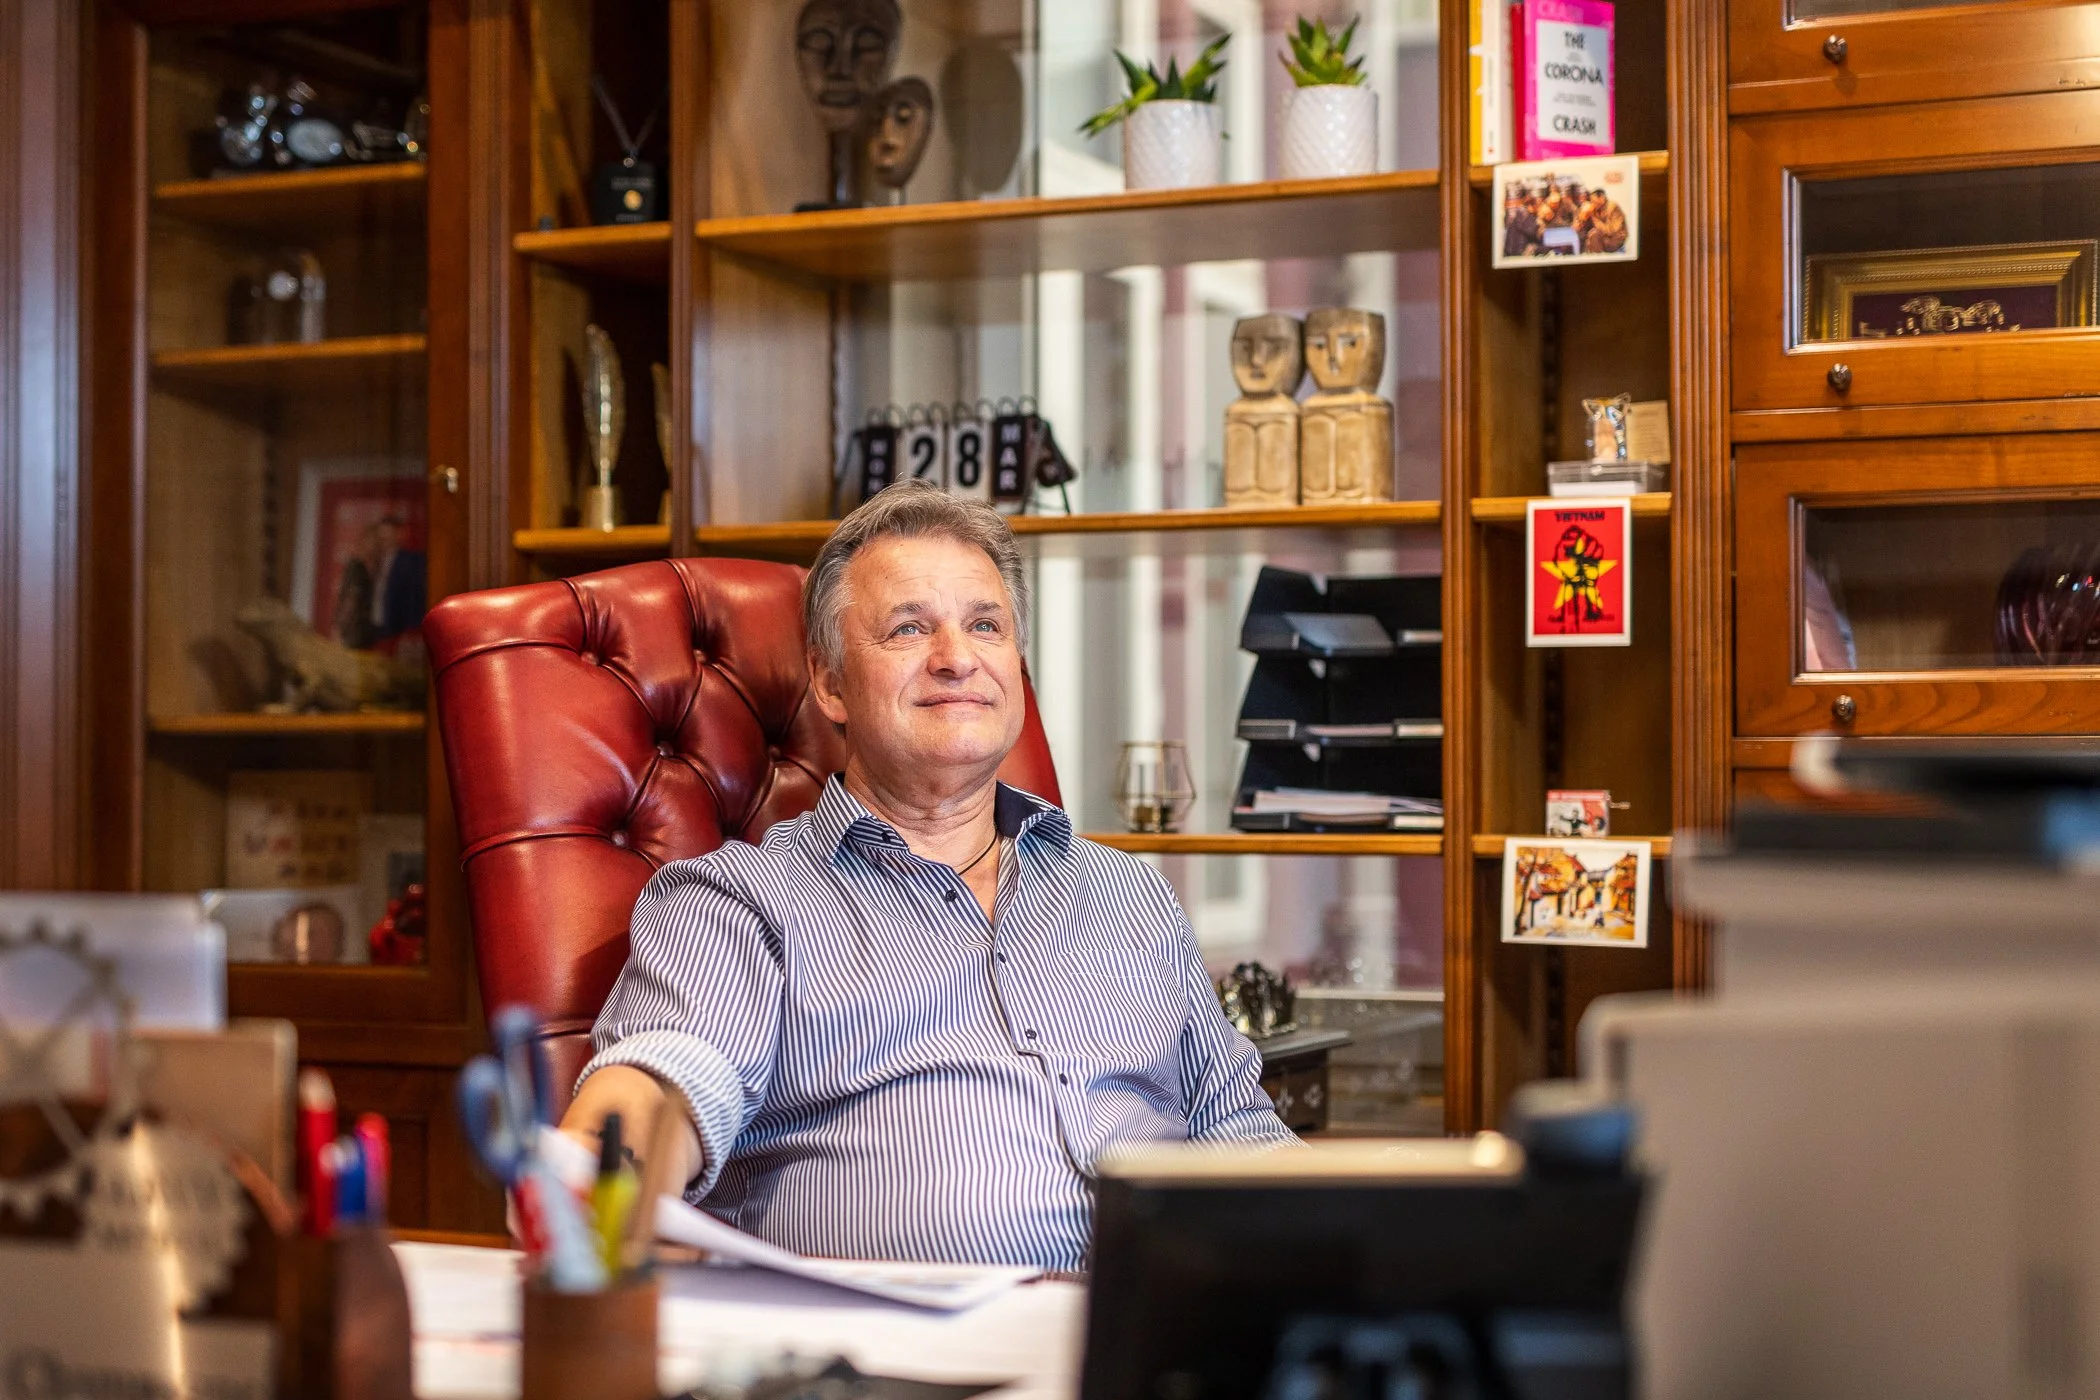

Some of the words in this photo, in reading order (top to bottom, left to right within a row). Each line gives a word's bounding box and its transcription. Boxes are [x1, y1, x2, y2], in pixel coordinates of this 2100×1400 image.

[1564, 31, 1586, 50] THE
[1544, 62, 1604, 85] CORONA
[1553, 113, 1597, 136] CRASH
[999, 423, 1021, 491] MAR
[1555, 510, 1606, 522] VIETNAM
